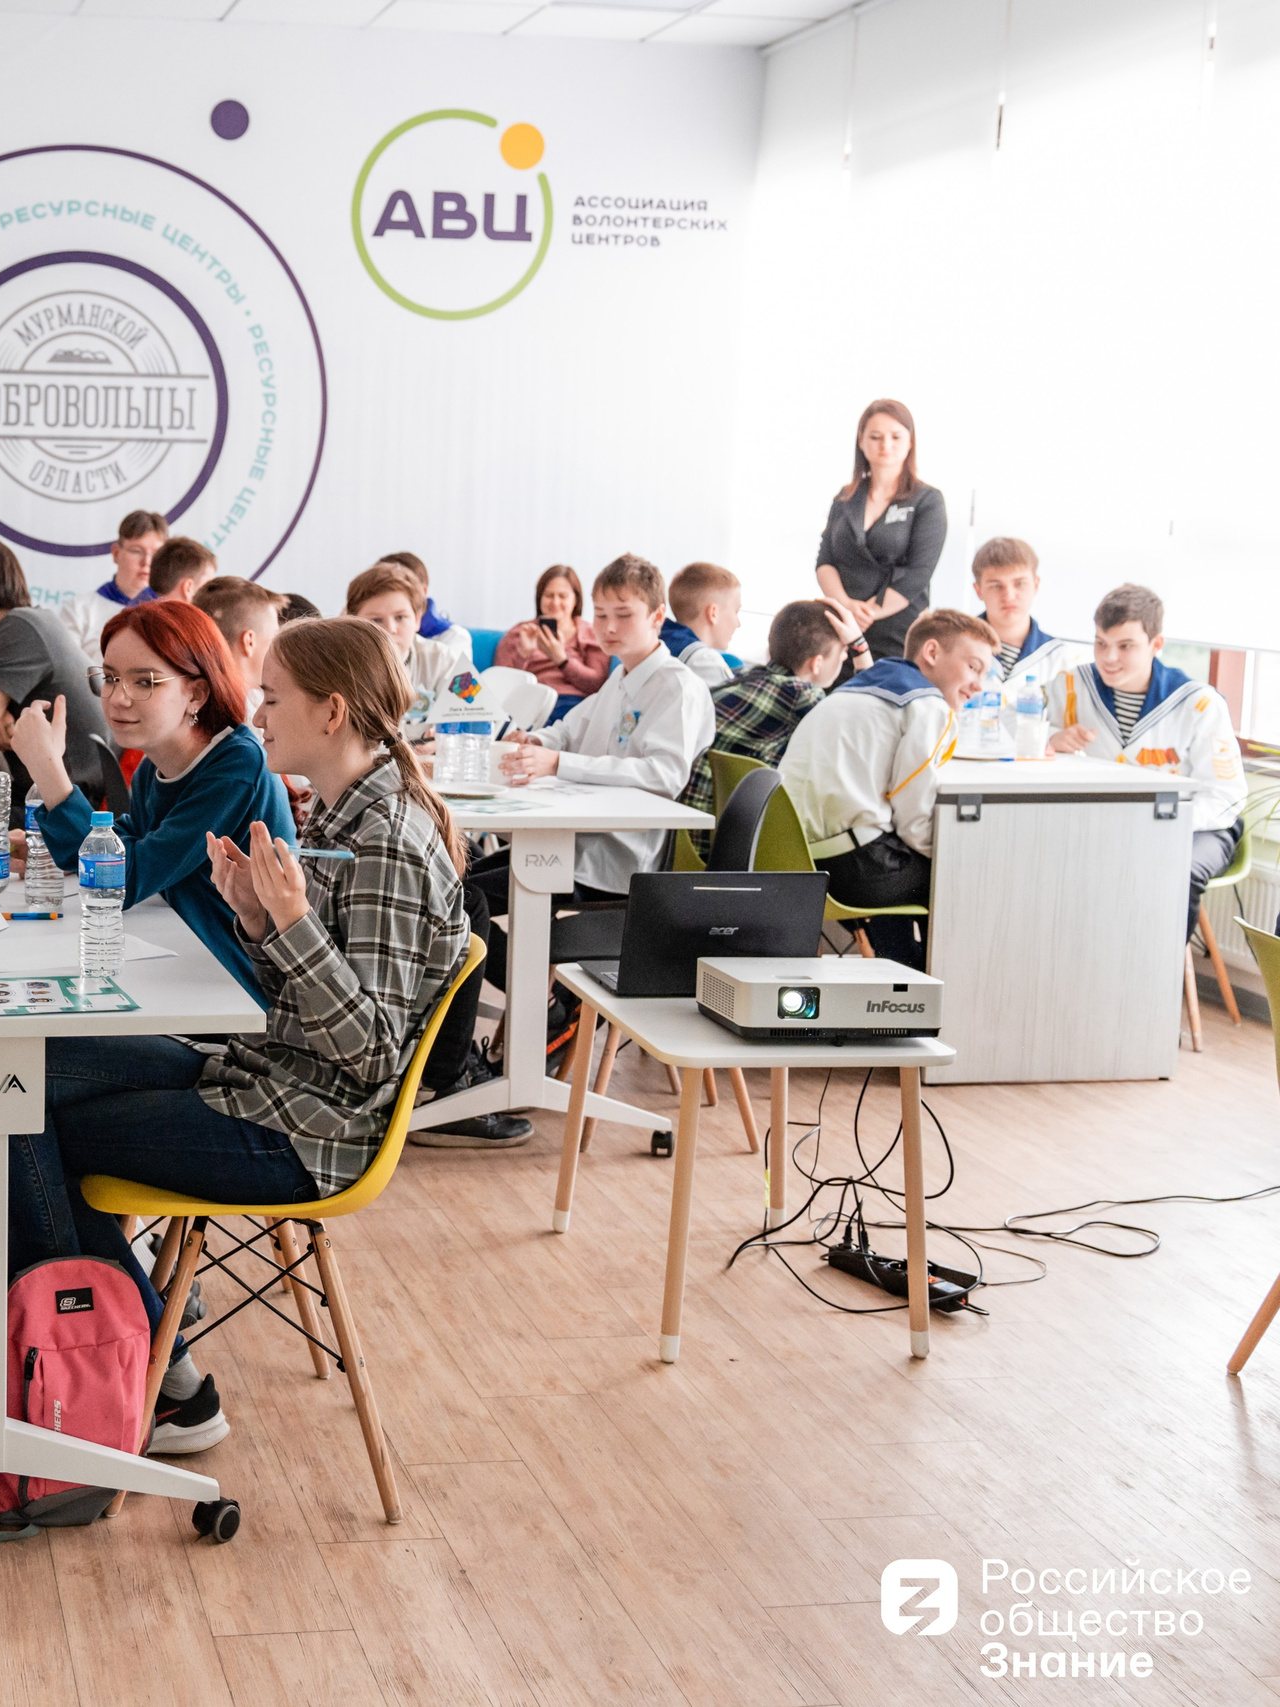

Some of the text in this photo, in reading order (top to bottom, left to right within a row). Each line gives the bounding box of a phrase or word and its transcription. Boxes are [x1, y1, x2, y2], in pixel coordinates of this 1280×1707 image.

[372, 190, 533, 242] АВЦ
[573, 195, 709, 212] АССОЦИАЦИЯ
[571, 214, 728, 231] ВОЛОНТЕРСКИХ
[571, 233, 661, 247] ЦЕНТРОВ
[161, 223, 247, 306] ЦЕНТРЫ
[13, 302, 149, 350] МУРМАНСКОЙ
[203, 323, 278, 553] РЕСУРСНЫЕ ЦЕНТ
[28, 459, 129, 494] ОБЛАСТИ
[708, 926, 739, 935] acer
[866, 1000, 925, 1013] InFocus
[53, 1399, 62, 1432] HERS
